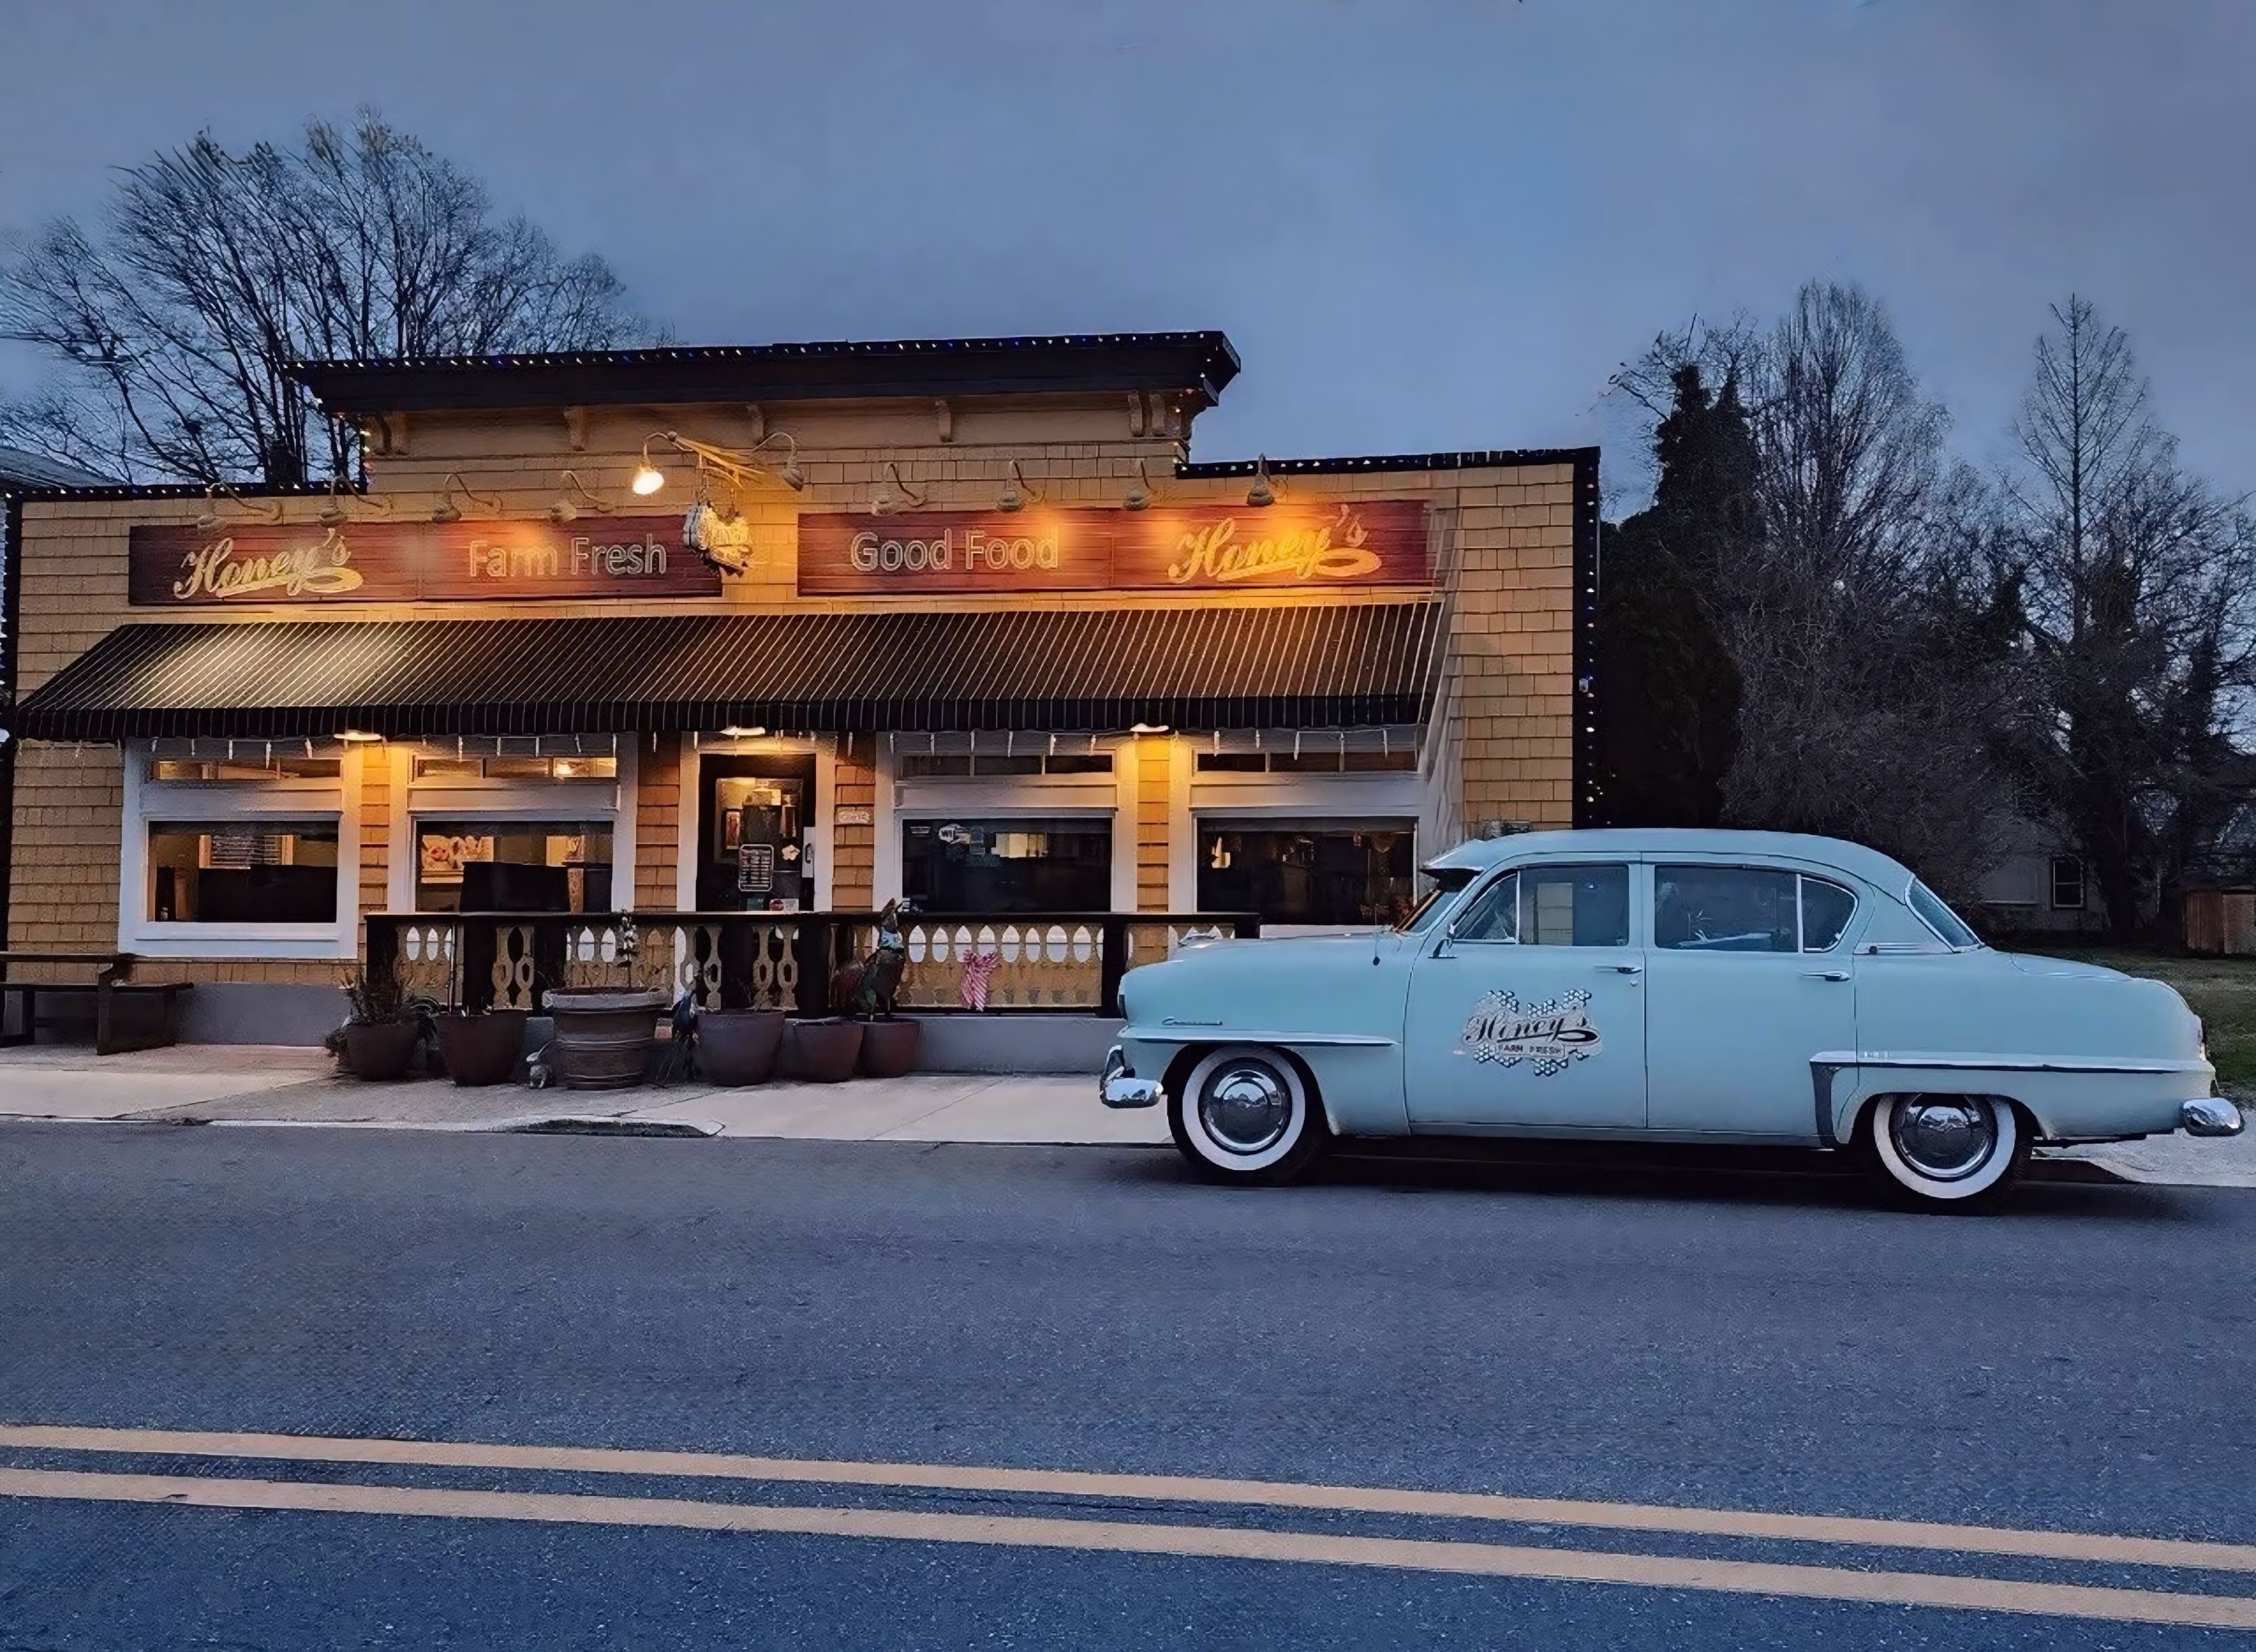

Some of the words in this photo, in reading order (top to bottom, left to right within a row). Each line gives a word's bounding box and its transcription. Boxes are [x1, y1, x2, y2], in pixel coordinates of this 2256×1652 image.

[173, 527, 364, 599] Honey's
[469, 540, 558, 577] Farm
[570, 534, 667, 575] Fresh
[851, 528, 952, 572] Good
[965, 527, 1059, 571] Food
[1167, 504, 1383, 584] Honey's
